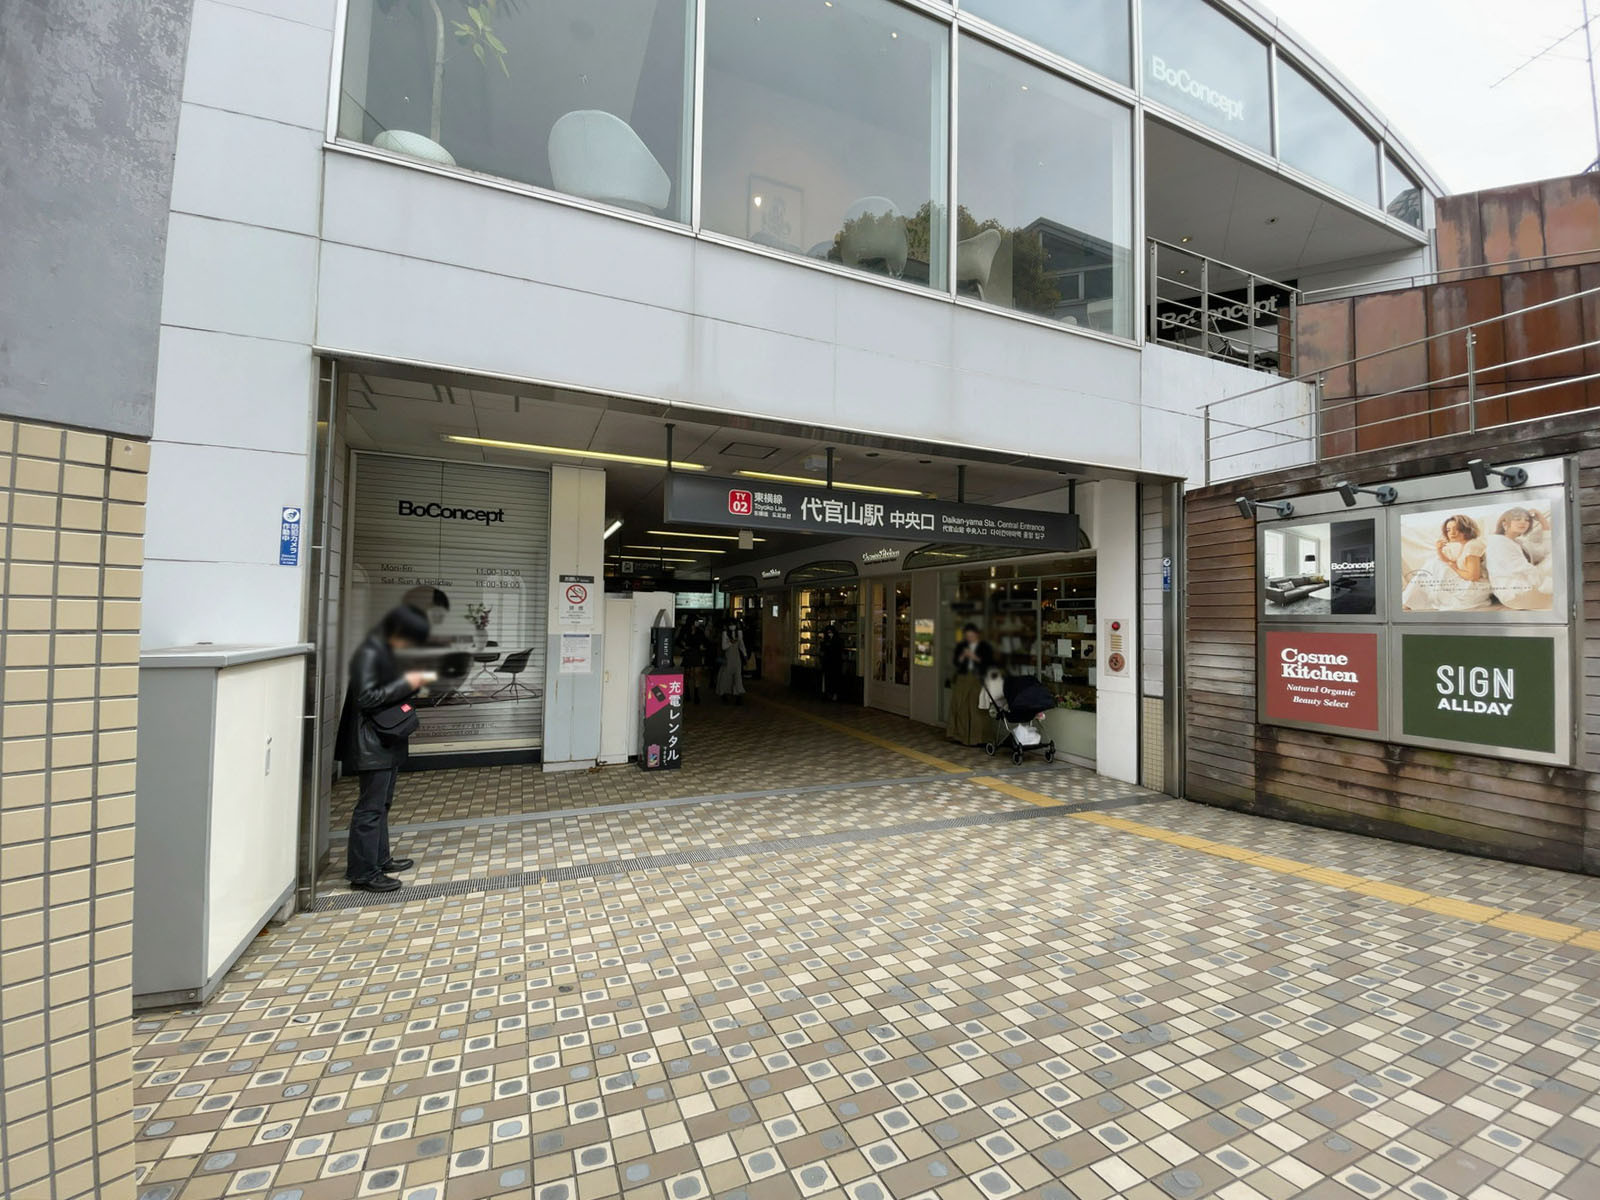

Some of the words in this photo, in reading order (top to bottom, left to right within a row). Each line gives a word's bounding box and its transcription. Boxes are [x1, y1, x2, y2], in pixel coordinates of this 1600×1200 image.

[1151, 55, 1245, 121] BoConcept
[735, 492, 747, 501] TY
[754, 491, 783, 505] 東横線
[398, 499, 505, 526] BoConcept
[732, 500, 748, 513] 02
[754, 503, 775, 512] Toyoko
[800, 496, 885, 528] 代官山駅
[889, 510, 935, 531] 中央口
[941, 515, 983, 527] Daikan-yama
[983, 519, 997, 527] Sta.
[997, 520, 1019, 529] Central
[1019, 522, 1046, 532] Entrance
[1331, 561, 1375, 571] BoConcept
[1280, 647, 1349, 666] Cosme
[1280, 662, 1359, 683] Kitchen
[1286, 683, 1319, 693] Natural
[1320, 687, 1356, 697] Organic
[1436, 664, 1514, 700] SIGN
[1293, 695, 1321, 707] Beauty
[1322, 698, 1349, 708] Select
[1437, 698, 1513, 717] ALLDAY
[668, 681, 682, 762] 充電レンタル
